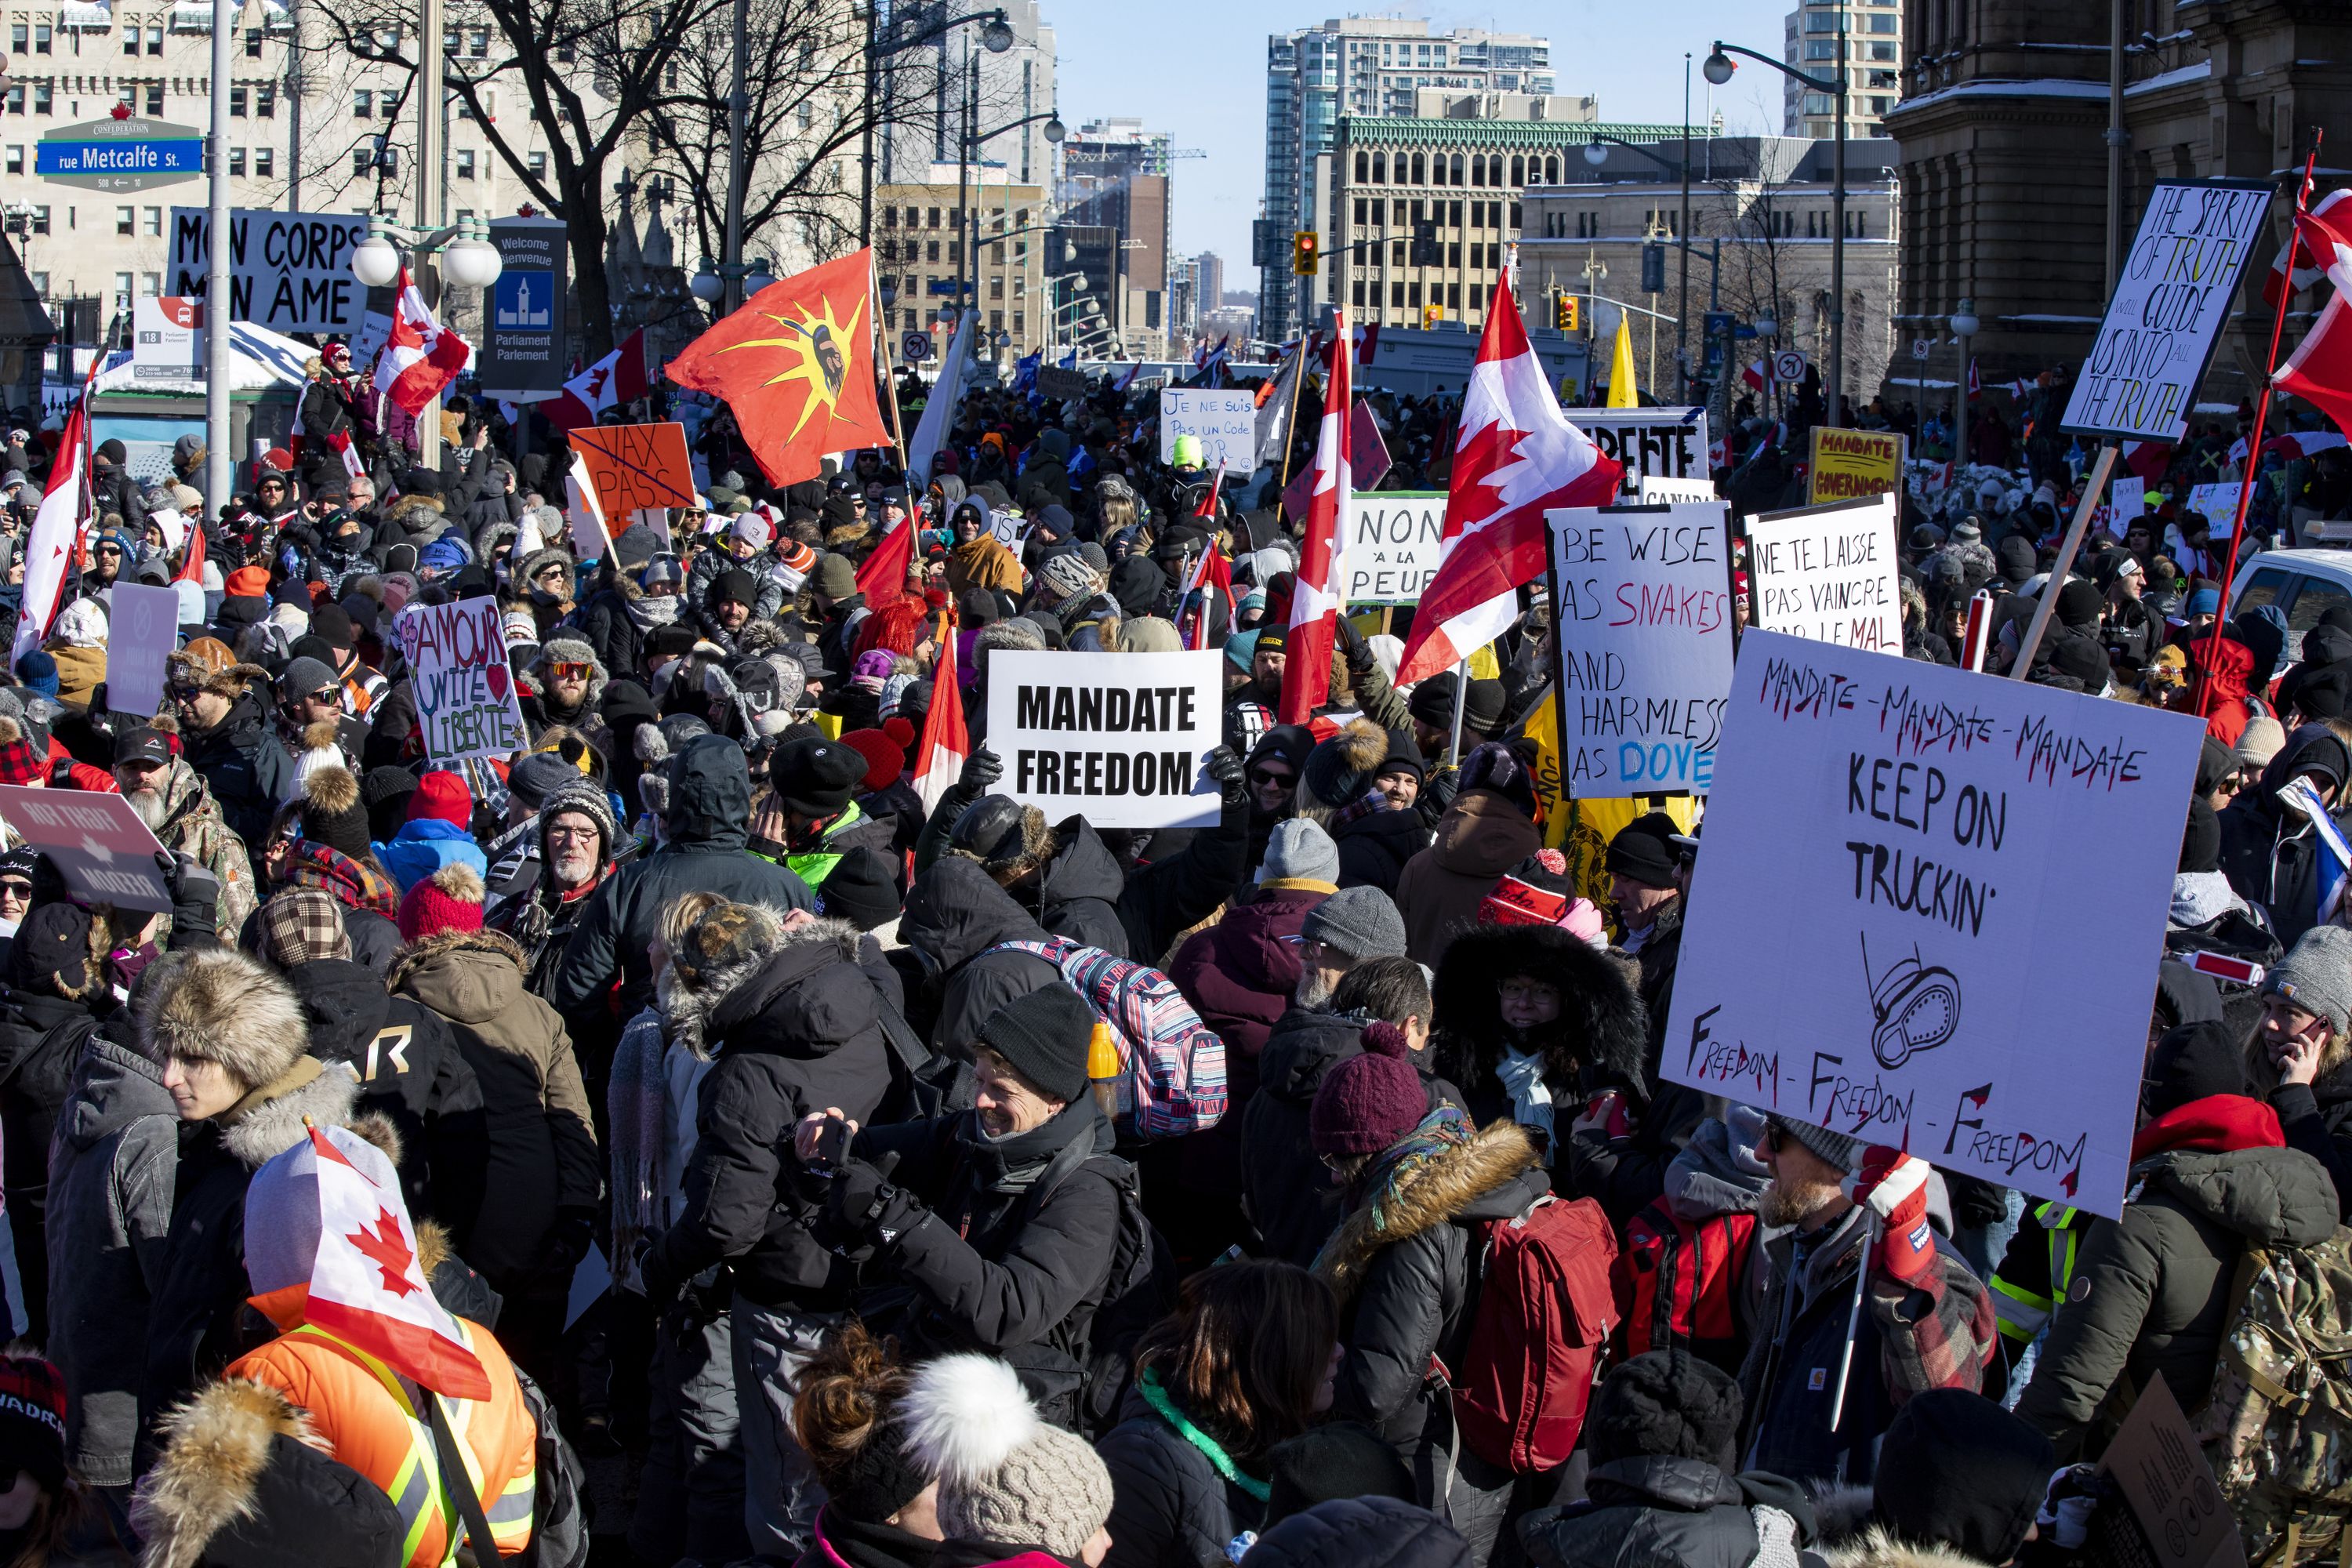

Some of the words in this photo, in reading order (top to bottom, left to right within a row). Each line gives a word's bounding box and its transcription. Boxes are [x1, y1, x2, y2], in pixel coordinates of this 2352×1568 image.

[59, 156, 78, 169] rue
[82, 144, 157, 169] Metcalfe
[165, 152, 180, 167] St.
[98, 179, 109, 187] 508
[135, 178, 141, 187] 10
[2151, 187, 2191, 234] THE
[2188, 188, 2266, 239] SPIRIT
[178, 215, 248, 266] MN
[264, 220, 364, 270] CORPS
[500, 253, 553, 267] Bienvenue
[502, 237, 549, 250] Welcome
[2130, 235, 2168, 280] OF
[2162, 236, 2248, 287] TRUTH
[176, 268, 253, 321] MN
[267, 263, 352, 324] ÂME
[2115, 296, 2138, 316] WILL
[2143, 283, 2213, 333] GUIDE
[144, 332, 157, 343] 18
[366, 322, 379, 334] Mon
[495, 334, 550, 346] Parliament
[358, 347, 372, 358] Mon
[497, 349, 549, 361] Parlement
[2090, 328, 2123, 375] US
[2112, 328, 2174, 379] INTO
[2170, 343, 2191, 363] ALL
[1200, 401, 1218, 412] NE
[2078, 376, 2118, 426] THE
[2108, 378, 2187, 434] TRUTH
[597, 424, 663, 467] VAX
[1820, 434, 1895, 459] MANDATE
[597, 469, 675, 510] PASS
[2197, 485, 2216, 499] Let
[1358, 509, 1446, 544] NON
[1563, 528, 1606, 564] BE
[1624, 526, 1717, 566] WISE
[1397, 551, 1415, 564] LA
[1755, 542, 1785, 575] NE
[1788, 539, 1817, 572] TE
[1824, 532, 1878, 569] LAISSE
[1560, 578, 1602, 620] AS
[1608, 583, 1727, 634] SNAKES
[1765, 587, 1802, 617] PAS
[1809, 575, 1889, 612] VAINCRE
[416, 604, 508, 669] AMOUR
[1849, 615, 1900, 652] MAL
[1567, 650, 1625, 691] AND
[428, 694, 516, 760] LIBERTÉ
[1017, 685, 1196, 732] MANDATE
[1581, 695, 1729, 754] HARMLESS
[1760, 657, 1858, 722] MANDATE
[1882, 684, 1995, 757] MANDATE
[2015, 714, 2148, 793] MANDATE
[1016, 750, 1192, 797] FREEDOM
[1572, 746, 1608, 781] AS
[1849, 752, 1946, 835] KEEP
[1954, 785, 2006, 851] ON
[1686, 1004, 1778, 1108] FREEDOM
[1809, 1051, 1915, 1153] FREEDOM
[1943, 1082, 2087, 1199] FREEDOM
